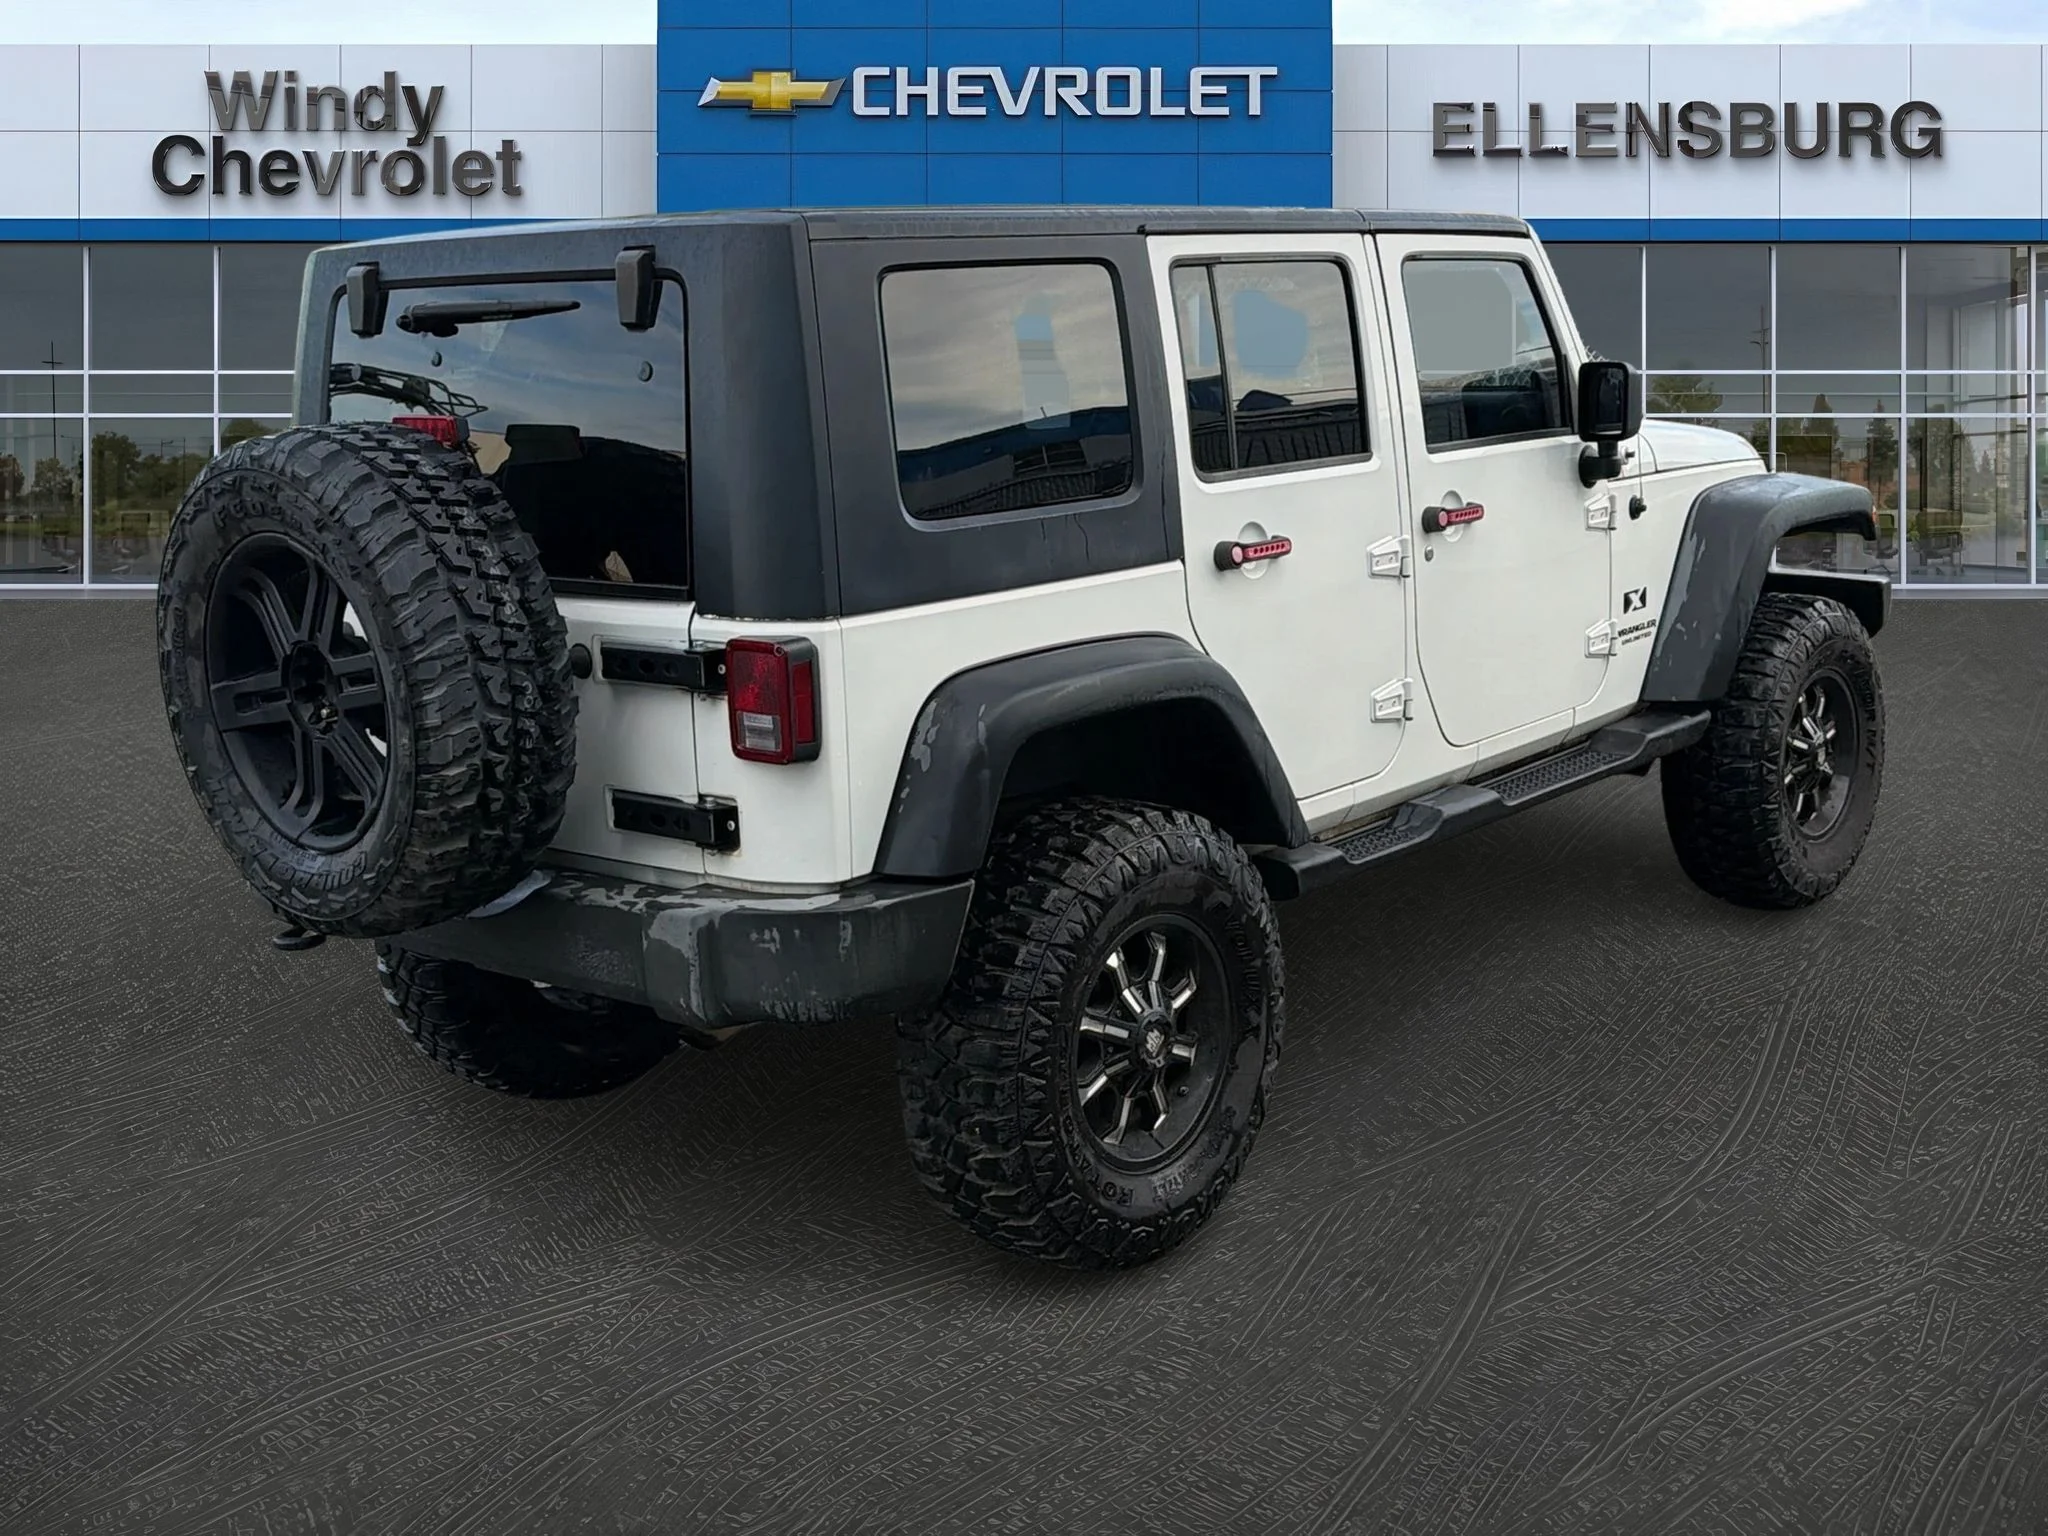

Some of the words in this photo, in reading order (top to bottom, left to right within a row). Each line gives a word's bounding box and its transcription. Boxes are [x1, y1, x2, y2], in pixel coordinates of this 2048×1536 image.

[204, 69, 445, 147] Windy
[852, 65, 1278, 117] CHEVROLET
[1432, 100, 1943, 159] ELLENSBURG
[151, 133, 523, 197] Chevrolet
[1617, 619, 1657, 637] WRANGLER
